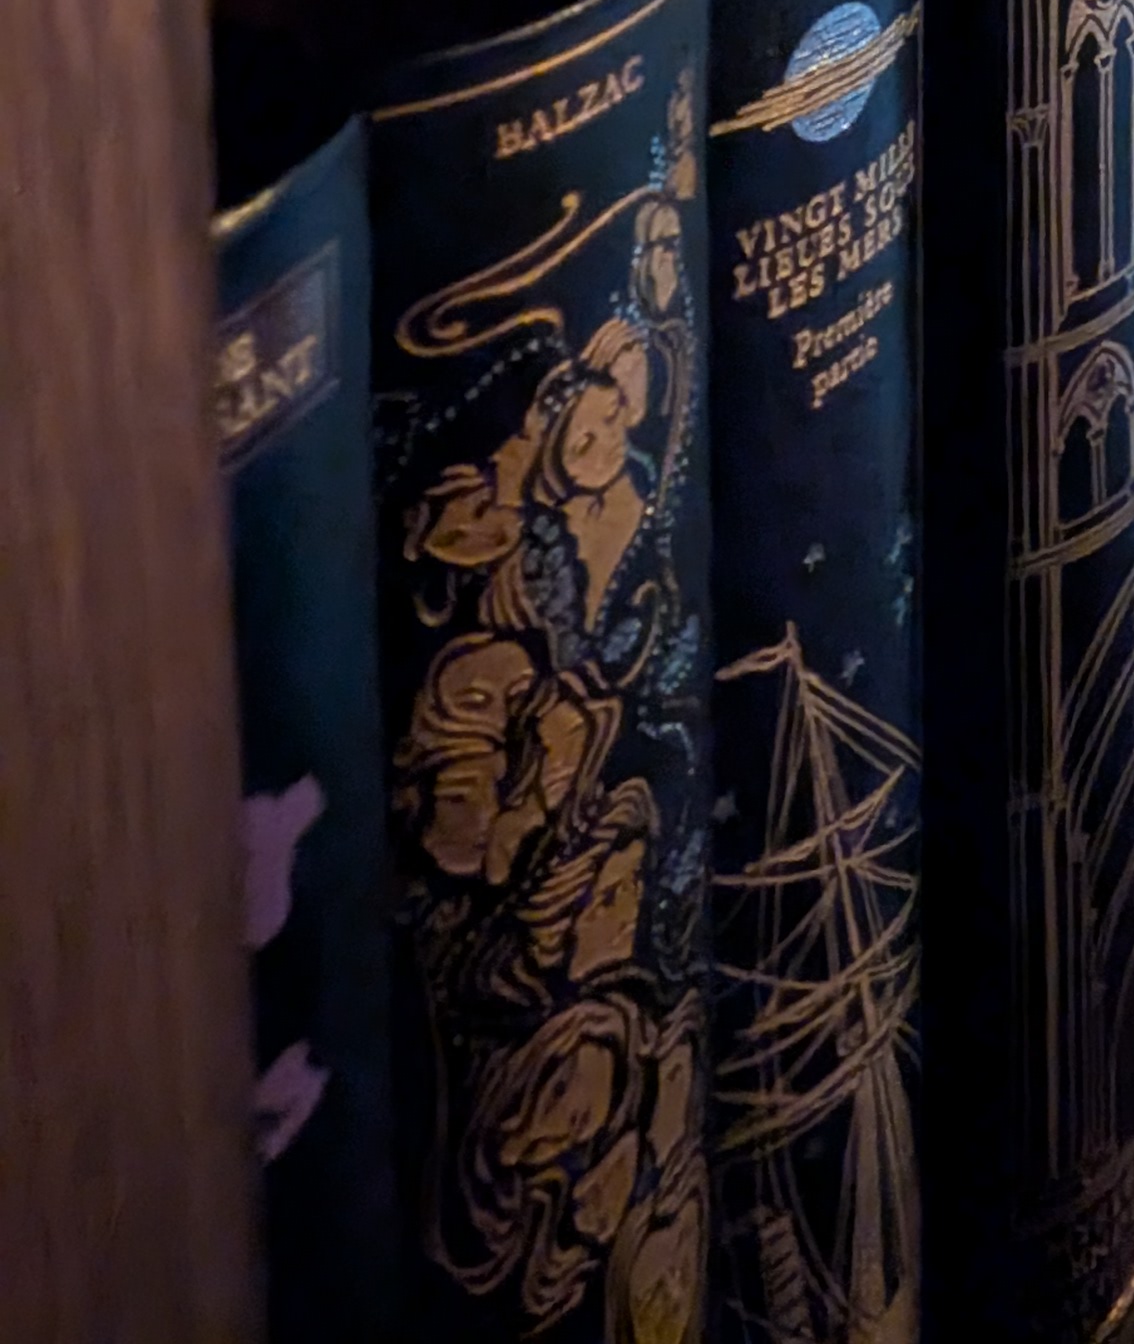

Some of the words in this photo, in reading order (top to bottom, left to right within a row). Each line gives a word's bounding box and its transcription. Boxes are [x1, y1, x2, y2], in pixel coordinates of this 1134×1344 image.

[493, 54, 647, 161] BALZAC
[735, 180, 849, 259] VINGT
[854, 118, 916, 202] MILL
[732, 212, 853, 301] LIEUES
[767, 262, 826, 320] LES
[836, 204, 903, 281] MERS
[792, 279, 894, 370] Première
[810, 333, 879, 410] partie
